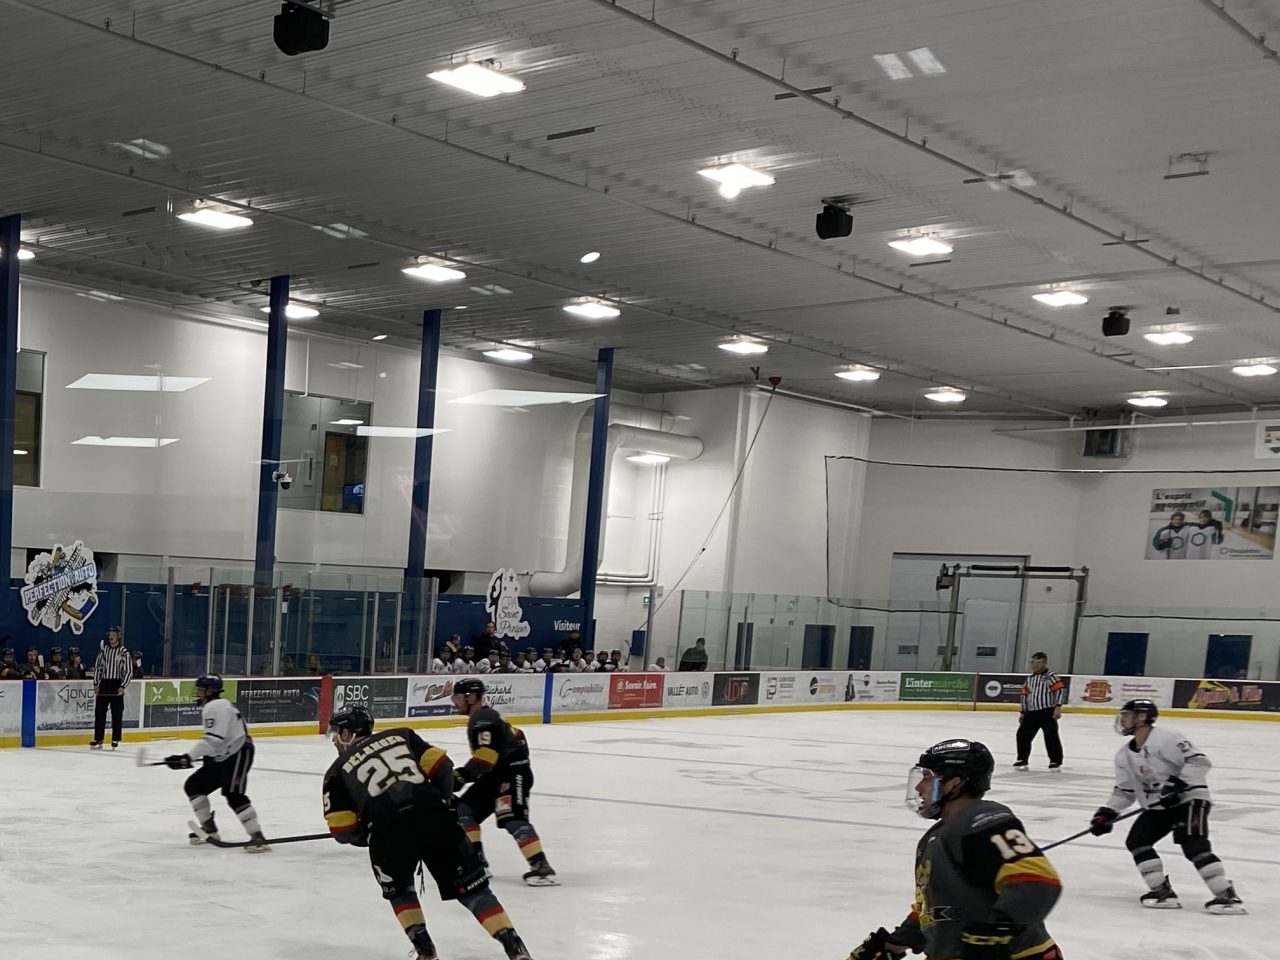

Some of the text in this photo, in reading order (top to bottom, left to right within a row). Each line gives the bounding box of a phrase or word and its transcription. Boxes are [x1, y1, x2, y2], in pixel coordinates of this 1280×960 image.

[554, 620, 581, 631] Visiteur
[345, 684, 369, 700] SBC
[357, 744, 425, 797] 25
[990, 829, 1035, 860] 13
